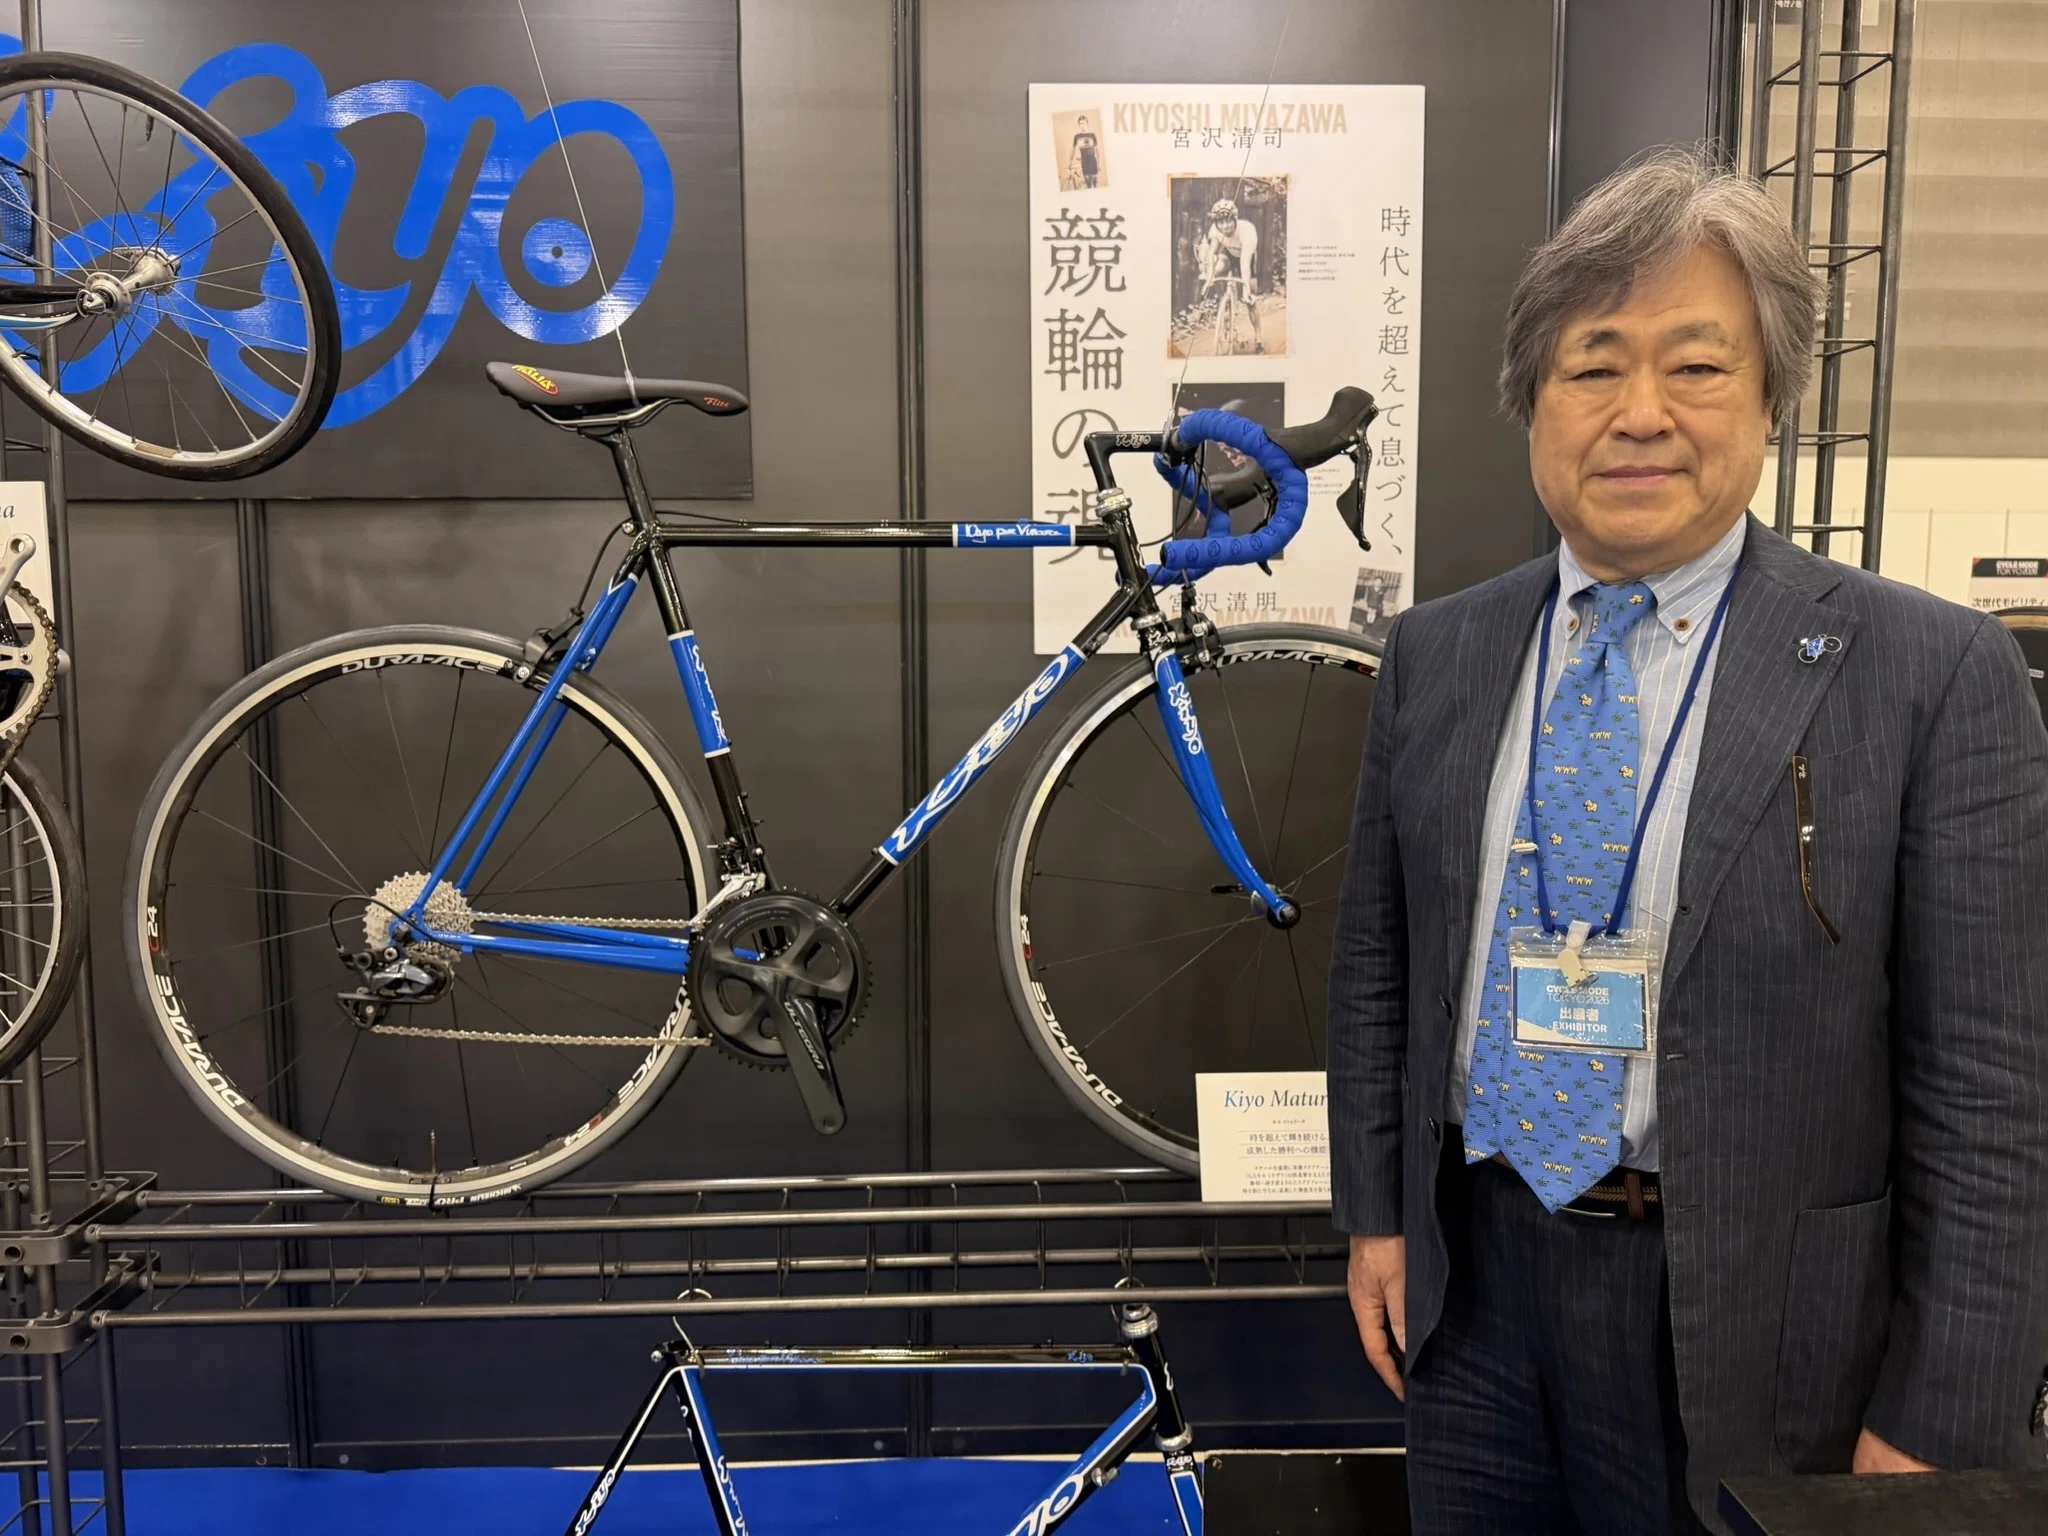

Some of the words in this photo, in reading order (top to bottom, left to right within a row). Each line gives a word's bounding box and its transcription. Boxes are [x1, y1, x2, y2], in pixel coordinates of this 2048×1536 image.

[1113, 103, 1210, 133] KIYOSHI
[1220, 103, 1347, 134] MIYAZAWA
[1171, 126, 1282, 149] 宮沢清司
[341, 653, 501, 675] DURA-ACE
[1547, 993, 1585, 1004] TOKYO
[1586, 995, 1609, 1005] 2026
[1560, 1007, 1599, 1022] 出展者
[784, 1001, 825, 1071] ULTEGRA
[1552, 1021, 1608, 1033] EXHIBITOR
[156, 974, 246, 1108] DURA-ACE
[1031, 981, 1123, 1107] DURA-ACE
[1224, 1090, 1265, 1114] Kiyo
[434, 1196, 465, 1206] PRO
[470, 1186, 513, 1203] MICHELIN
